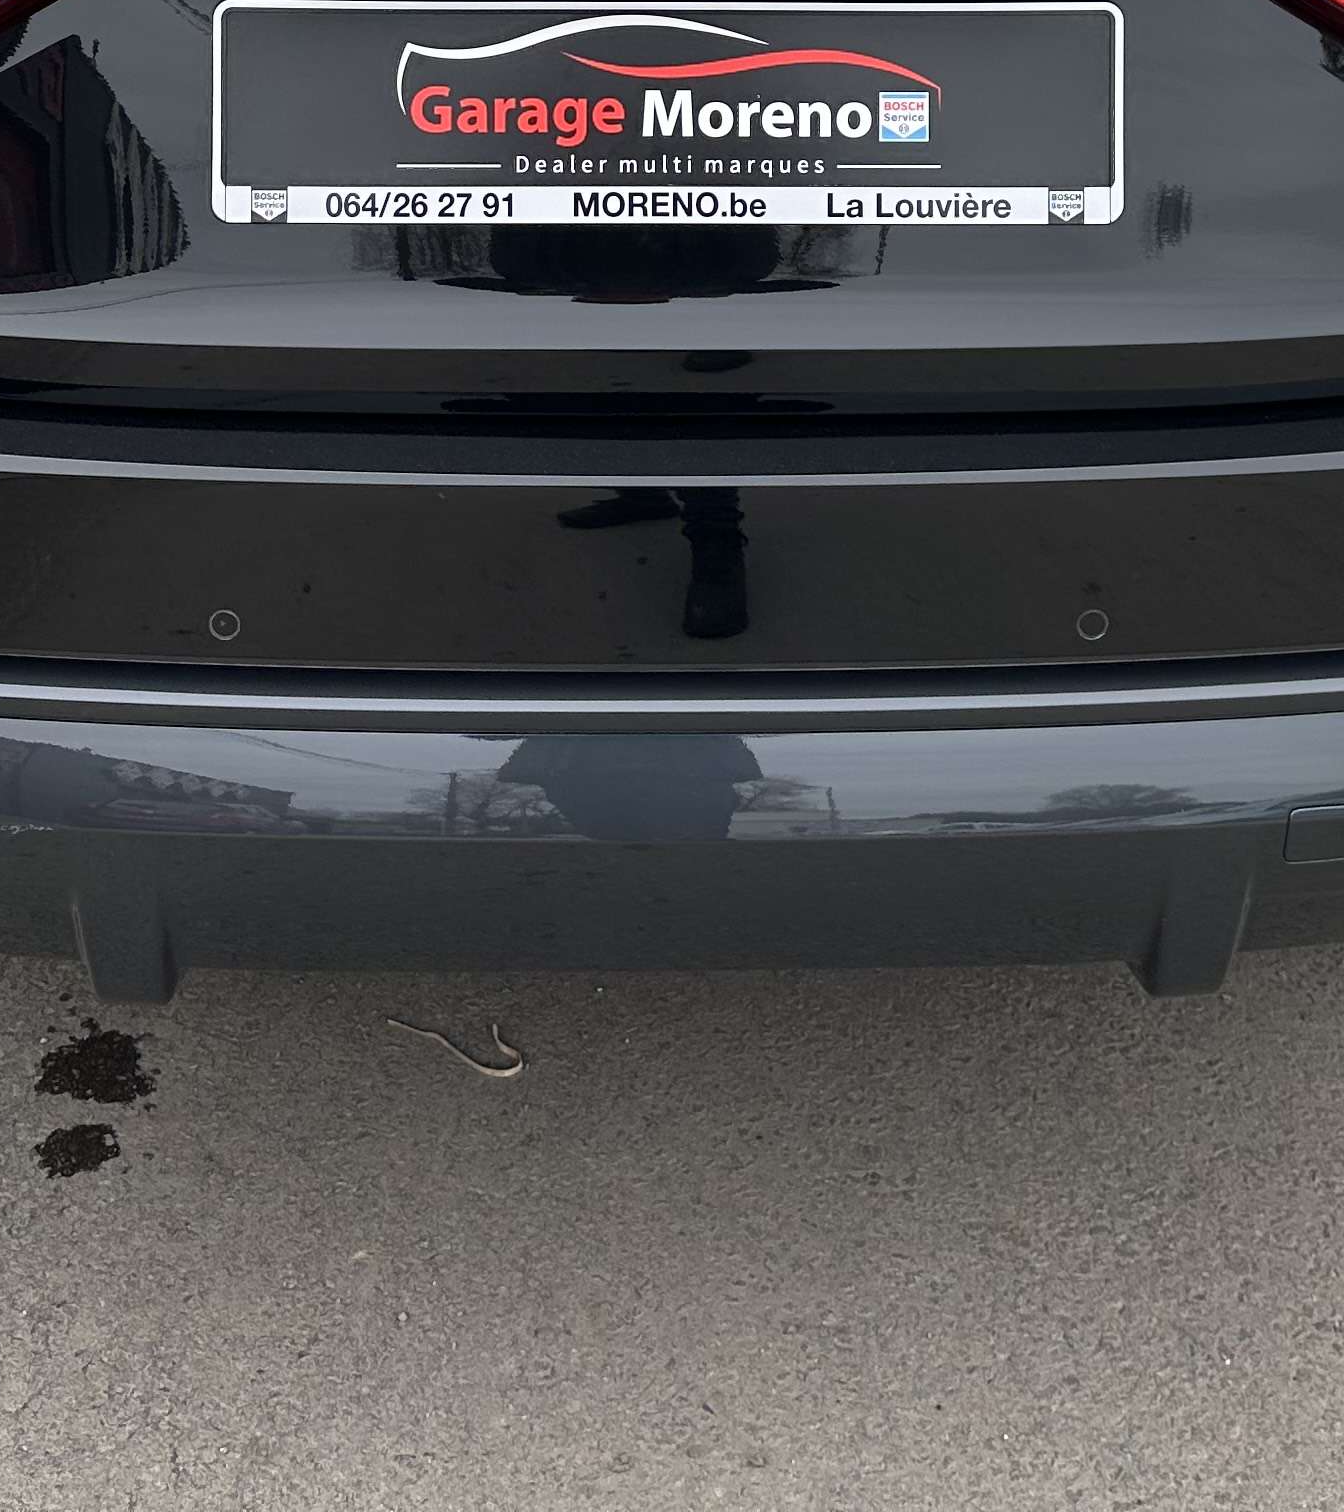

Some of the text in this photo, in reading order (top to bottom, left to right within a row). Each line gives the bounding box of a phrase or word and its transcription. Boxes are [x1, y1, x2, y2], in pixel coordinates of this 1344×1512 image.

[884, 101, 925, 111] BOSCH
[410, 85, 873, 147] Garage Moreno
[883, 112, 926, 122] Service
[515, 154, 825, 178] Dealer multi marques
[254, 192, 285, 200] BOSCH
[1051, 193, 1082, 201] BOSCH
[325, 192, 1012, 218] 064/26 27 91 MORENO.be La Louvière
